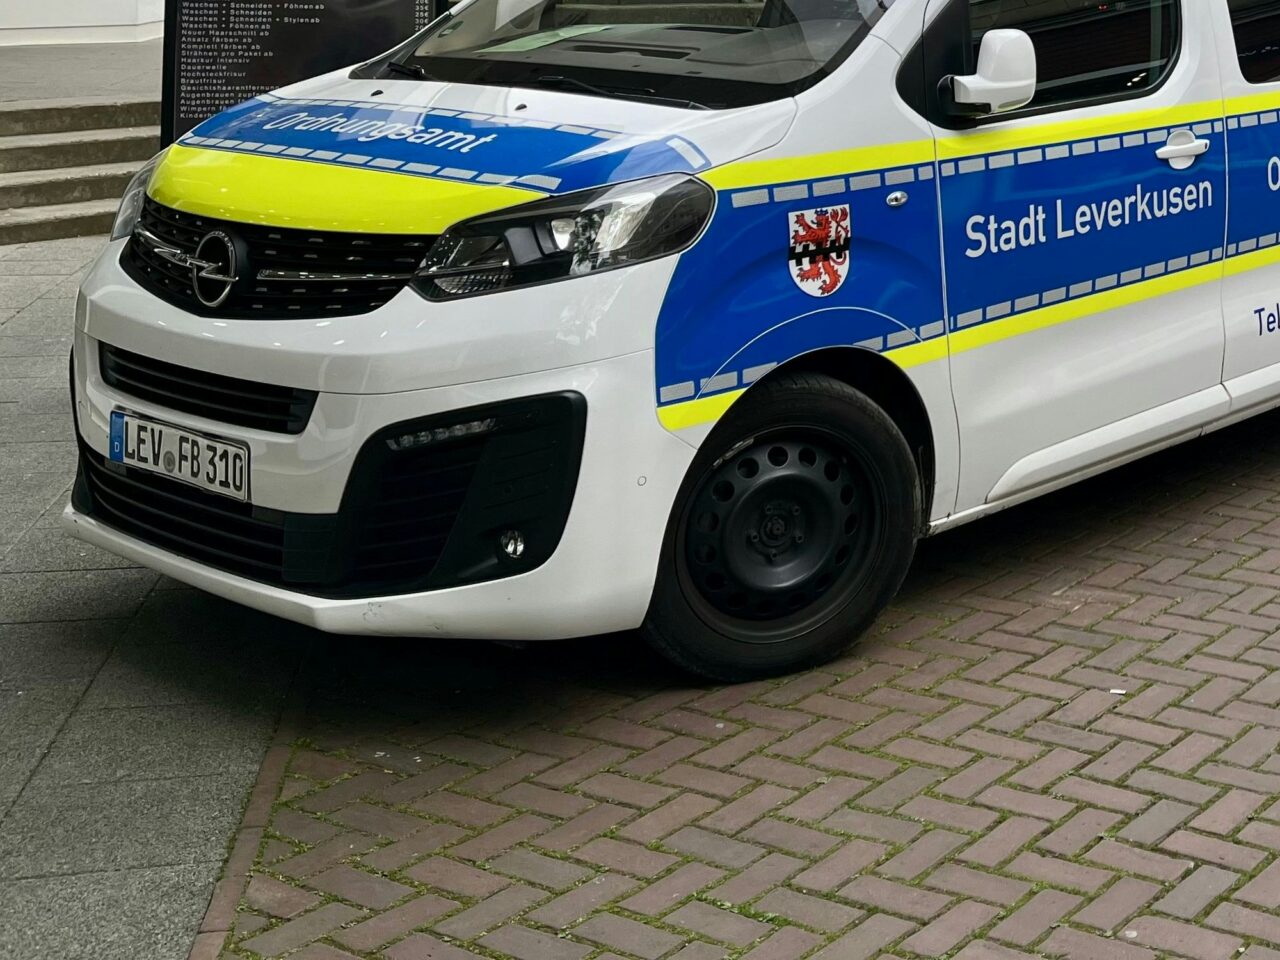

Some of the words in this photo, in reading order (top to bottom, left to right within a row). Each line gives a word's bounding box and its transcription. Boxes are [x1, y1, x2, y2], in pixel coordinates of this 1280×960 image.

[262, 112, 498, 154] Ordnungsamt
[965, 205, 1047, 259] Stadt
[1055, 178, 1214, 240] Leverkusen
[125, 421, 163, 467] LEV
[178, 435, 200, 478] FB
[206, 444, 243, 493] 310
